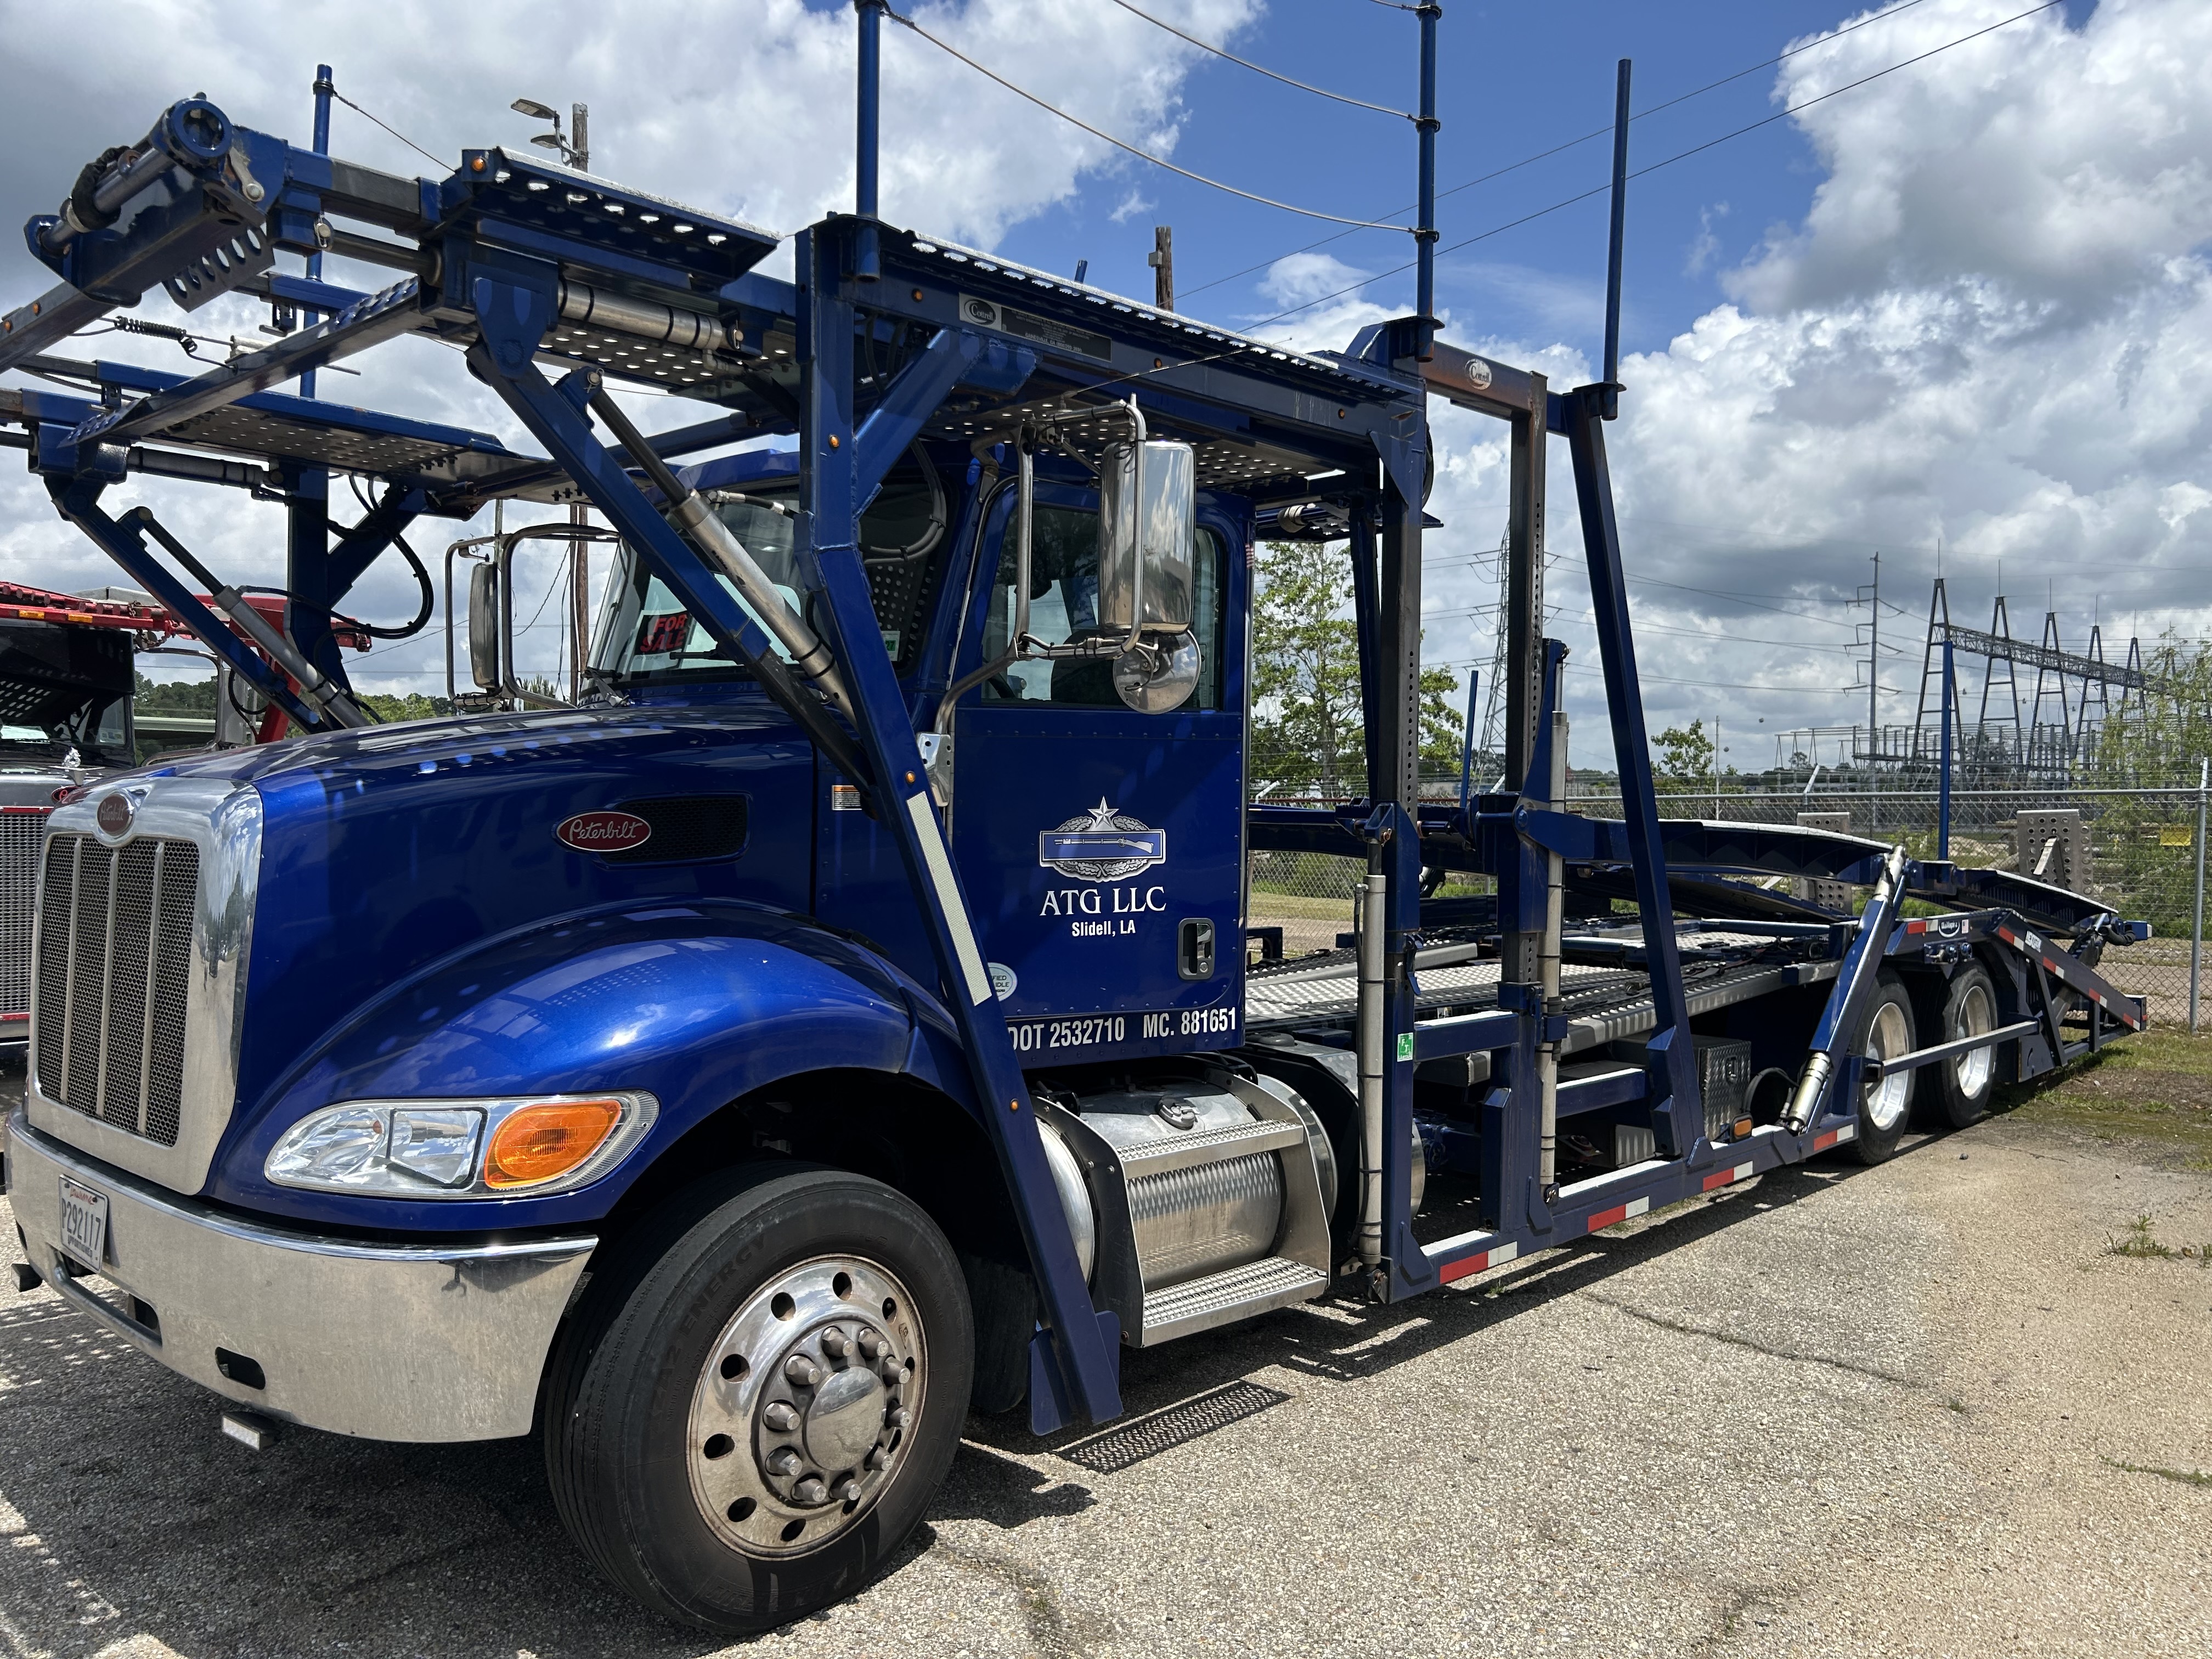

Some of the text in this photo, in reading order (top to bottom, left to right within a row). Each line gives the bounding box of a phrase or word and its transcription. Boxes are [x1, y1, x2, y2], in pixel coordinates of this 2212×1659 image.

[653, 614, 687, 633] FOR
[640, 630, 686, 652] SALE
[100, 801, 128, 823] Peterbilt
[569, 819, 644, 842] Peterbilt
[1039, 886, 1166, 916] ATG LLC
[1071, 919, 1136, 937] Slidell, LA
[1049, 1017, 1125, 1048] 2532710
[1143, 1013, 1175, 1039] MC.
[1181, 1007, 1236, 1035] 881651
[61, 1198, 101, 1251] P292117
[676, 1232, 766, 1338] ENERGY
